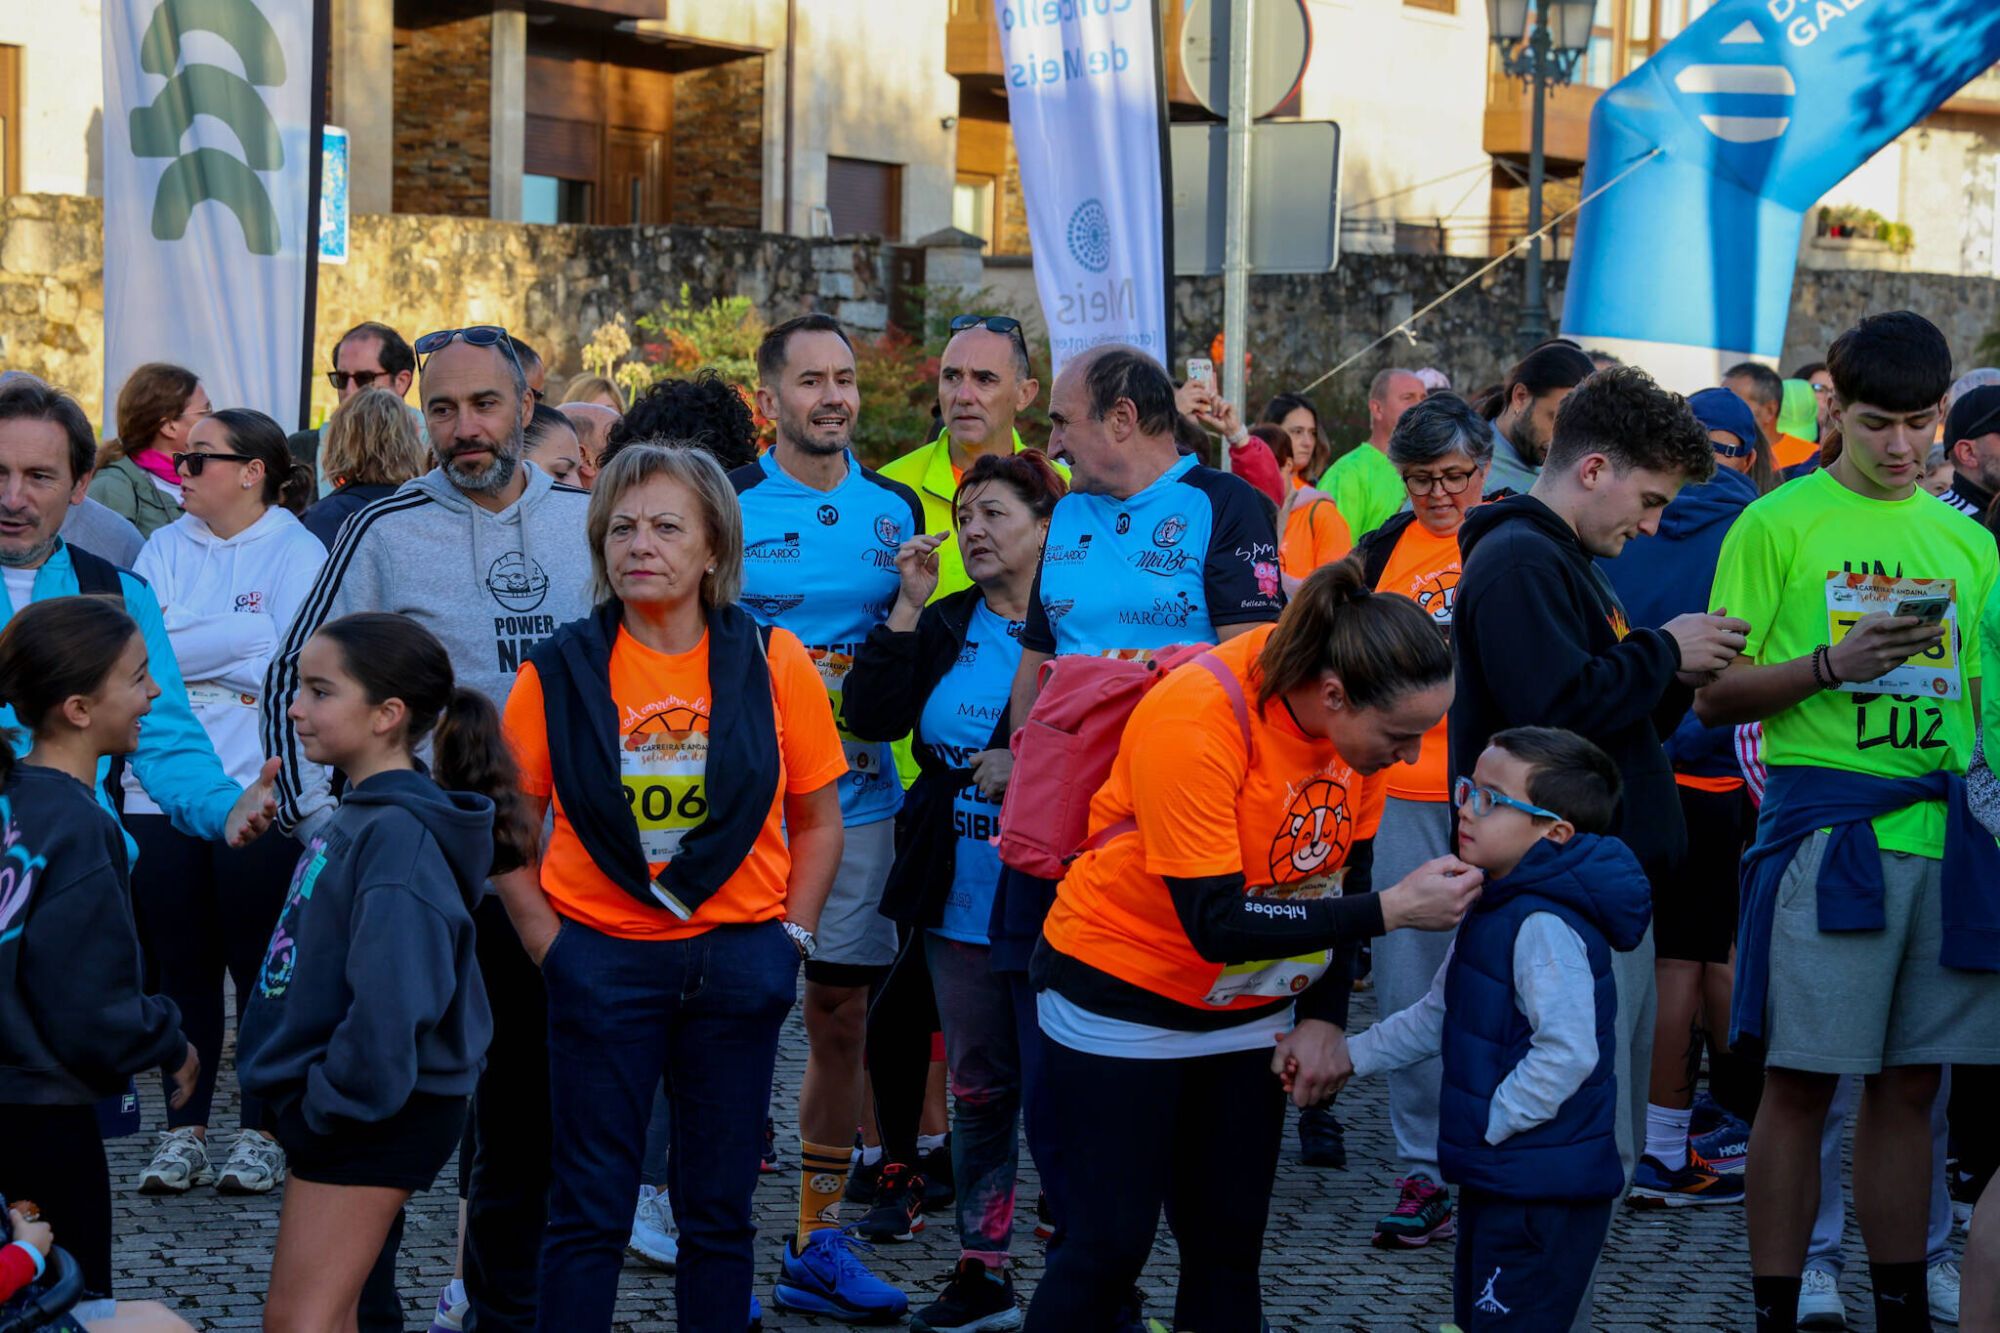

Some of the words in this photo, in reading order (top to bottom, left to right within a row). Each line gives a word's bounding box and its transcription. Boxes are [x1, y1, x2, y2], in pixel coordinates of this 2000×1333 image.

[1152, 597, 1187, 614] SAN
[494, 614, 555, 637] POWER
[1118, 610, 1188, 629] MARCOS
[1856, 706, 1949, 751] LUZ
[641, 742, 680, 753] CARREIRA
[1244, 901, 1308, 920] hibobes
